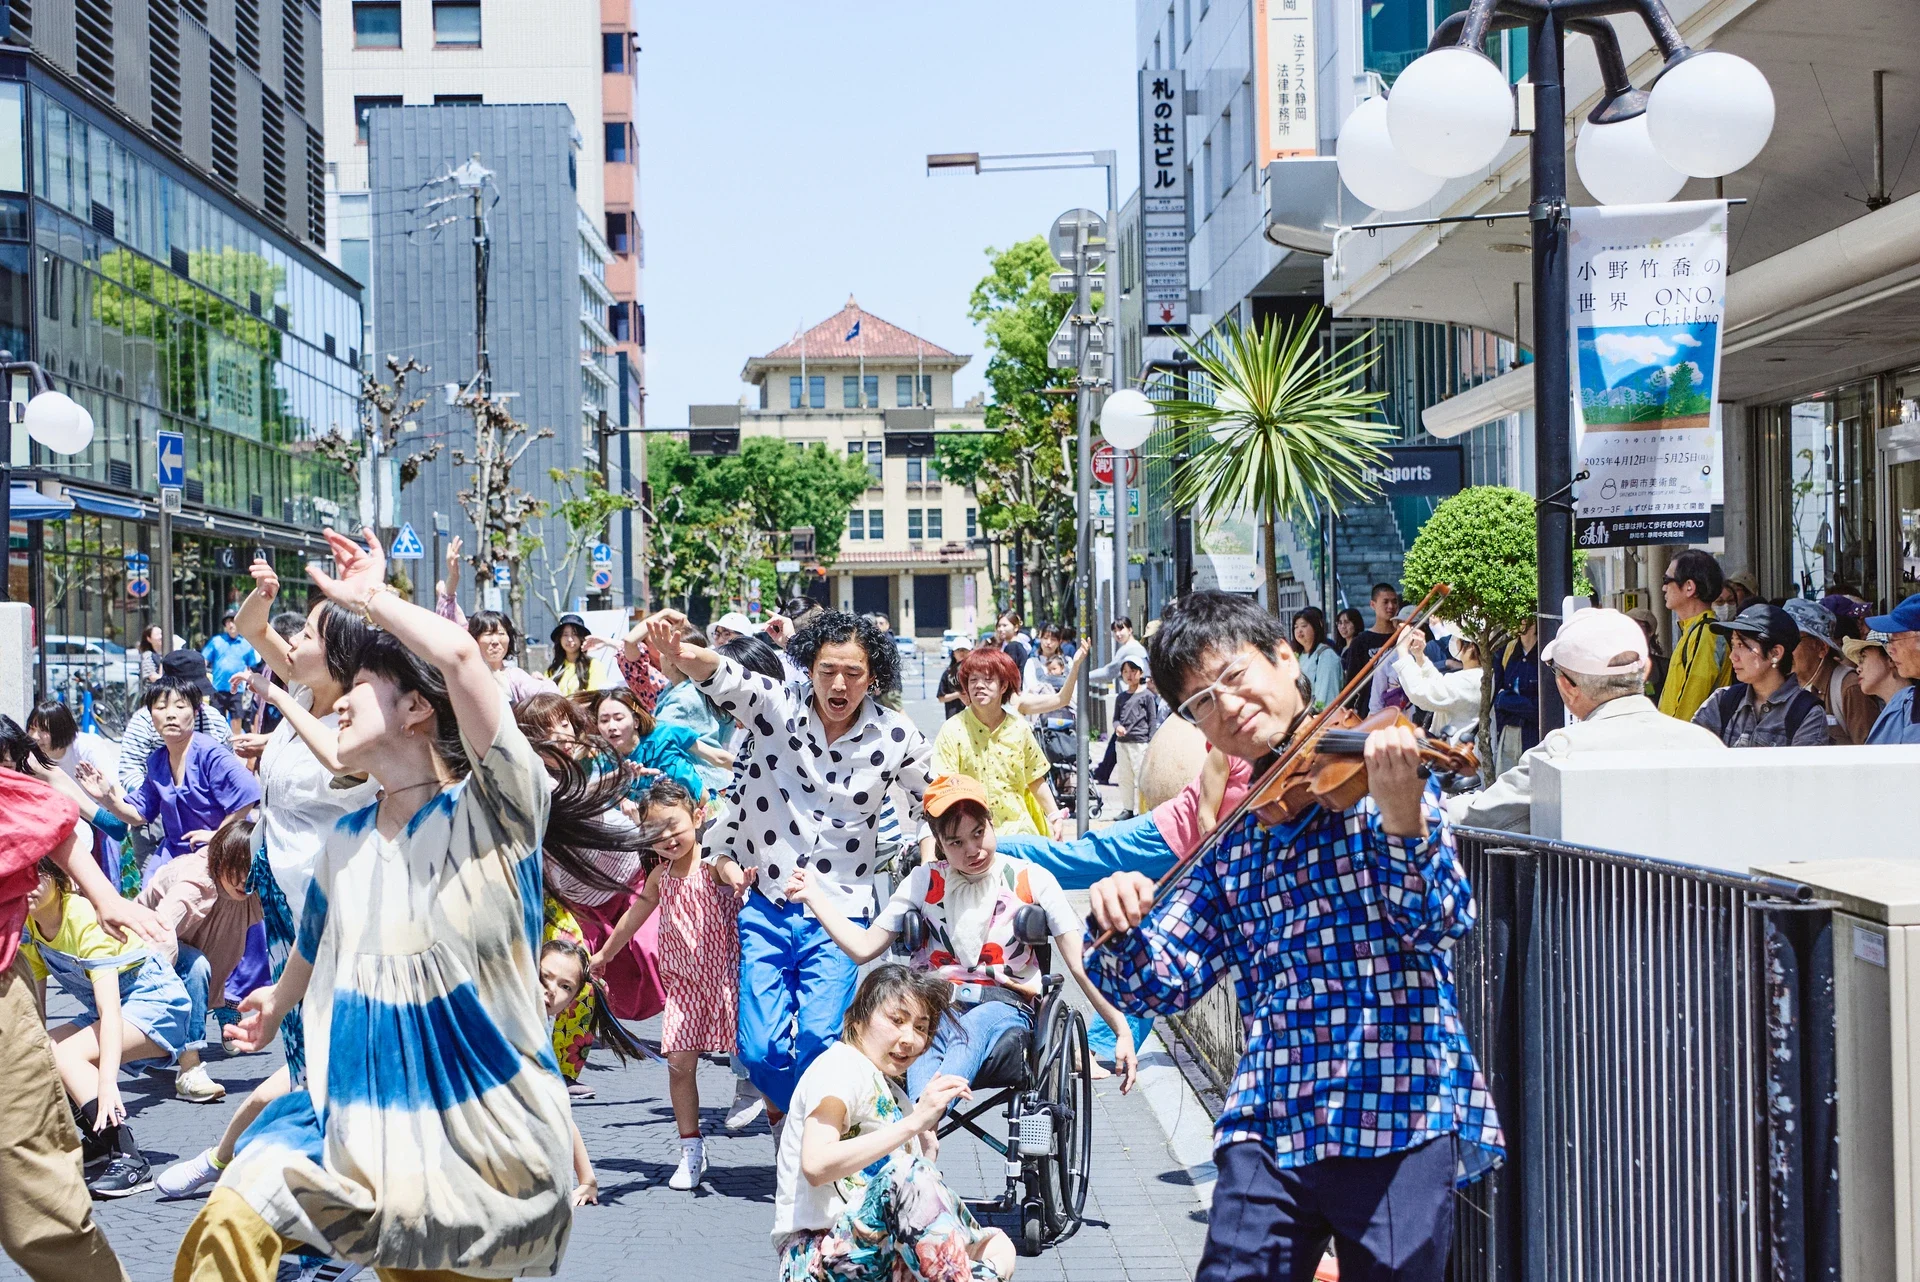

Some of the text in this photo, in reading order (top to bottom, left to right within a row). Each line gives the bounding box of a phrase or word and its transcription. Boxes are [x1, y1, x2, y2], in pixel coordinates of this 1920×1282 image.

[1293, 34, 1307, 121] 法テラス静岡
[1277, 64, 1290, 136] 法律事務所
[1151, 77, 1176, 189] 札の辻ビル
[1576, 256, 1721, 281] 小野竹喬の
[1576, 291, 1629, 313] 世界
[1655, 286, 1715, 306] ONO,
[1620, 477, 1678, 489] 静岡市美術館
